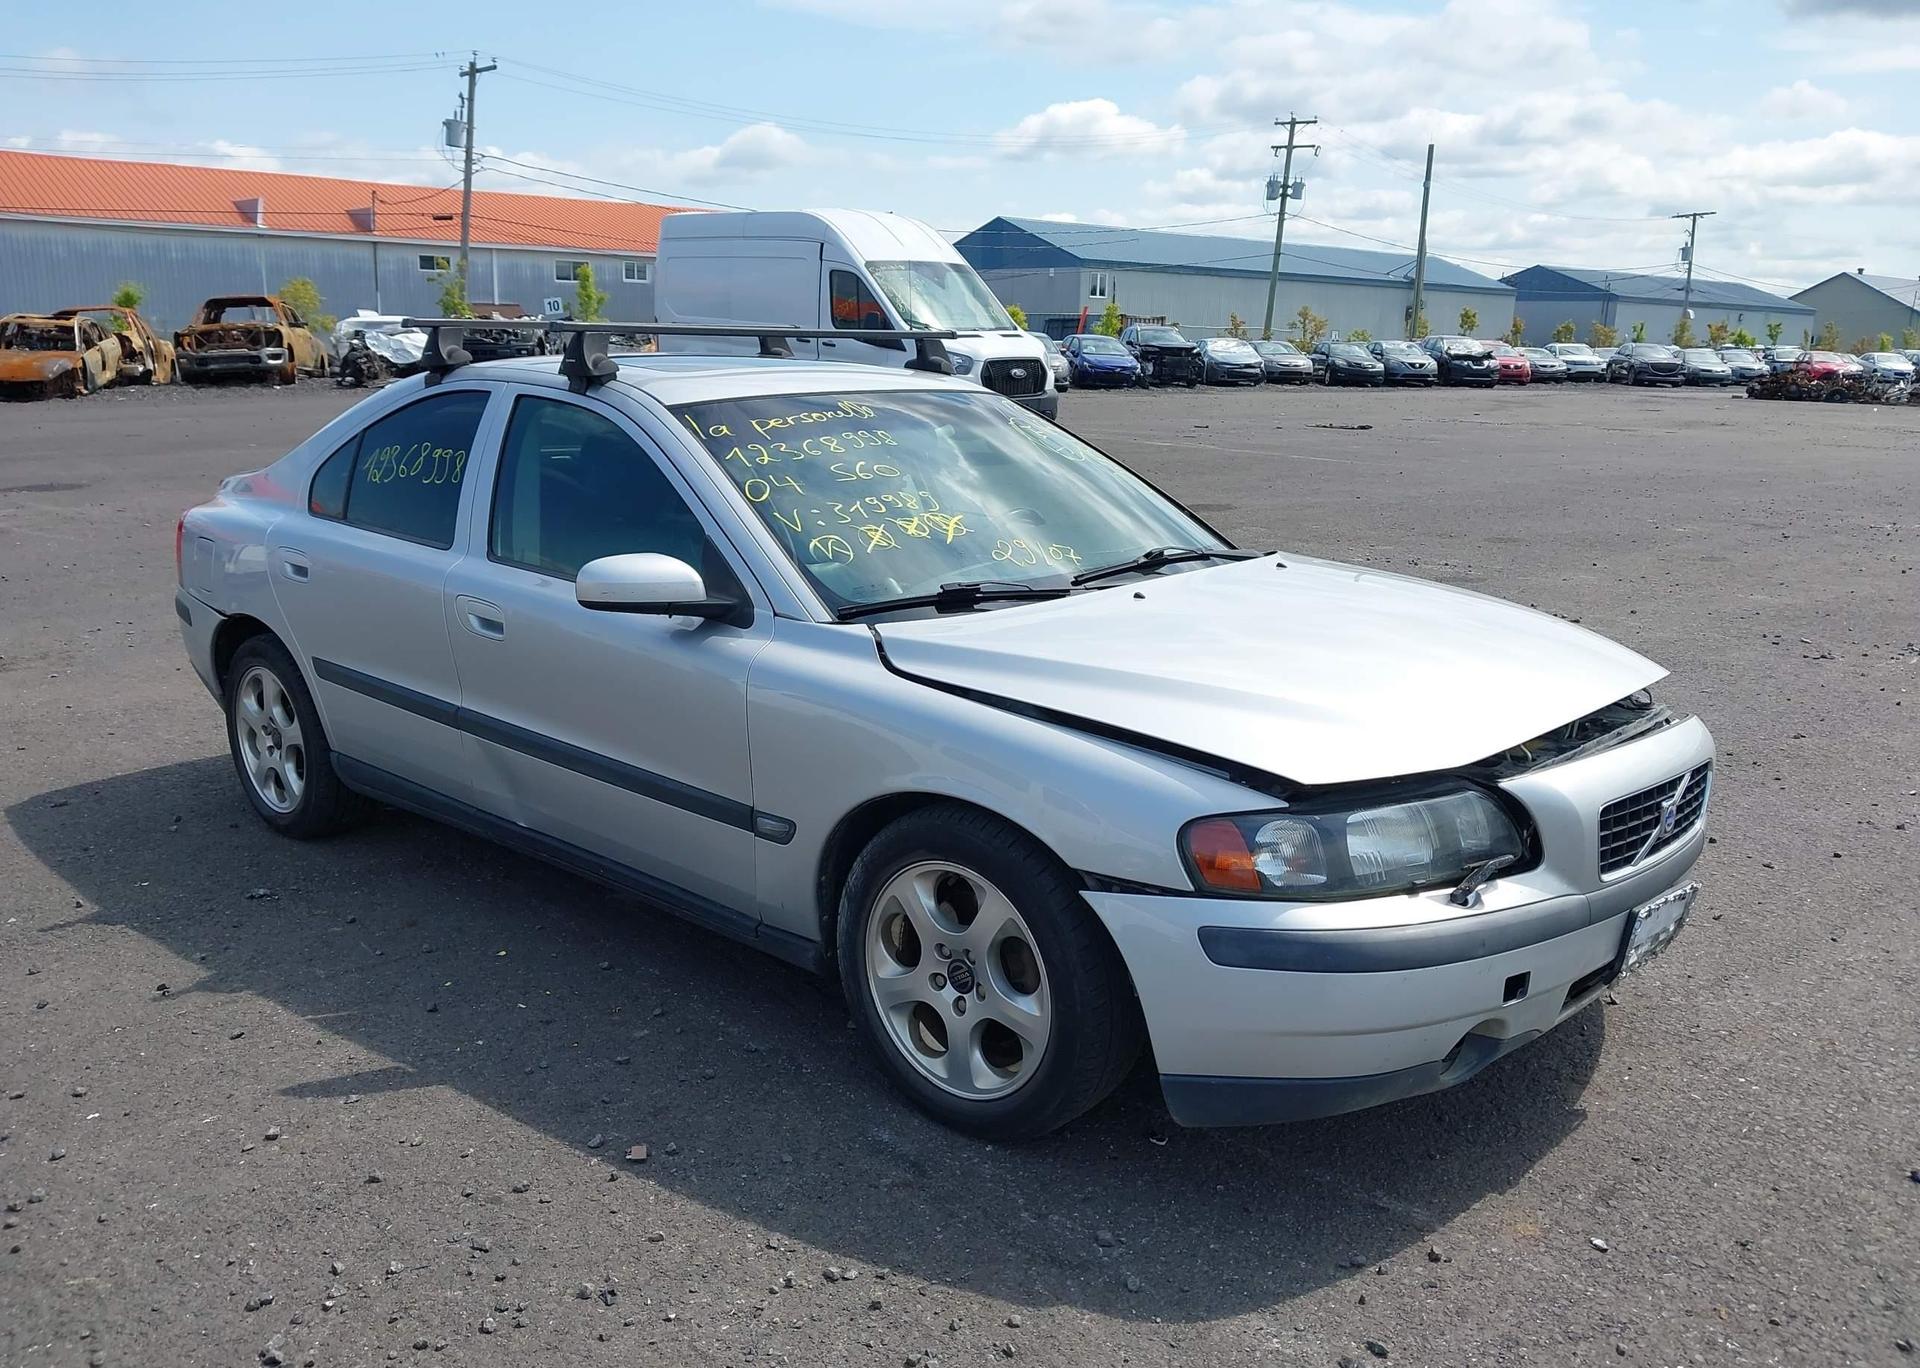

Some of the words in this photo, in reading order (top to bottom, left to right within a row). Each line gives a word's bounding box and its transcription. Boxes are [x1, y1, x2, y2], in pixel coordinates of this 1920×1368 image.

[547, 300, 559, 311] 10
[363, 442, 466, 484] 12368998
[726, 429, 898, 467] 12368998
